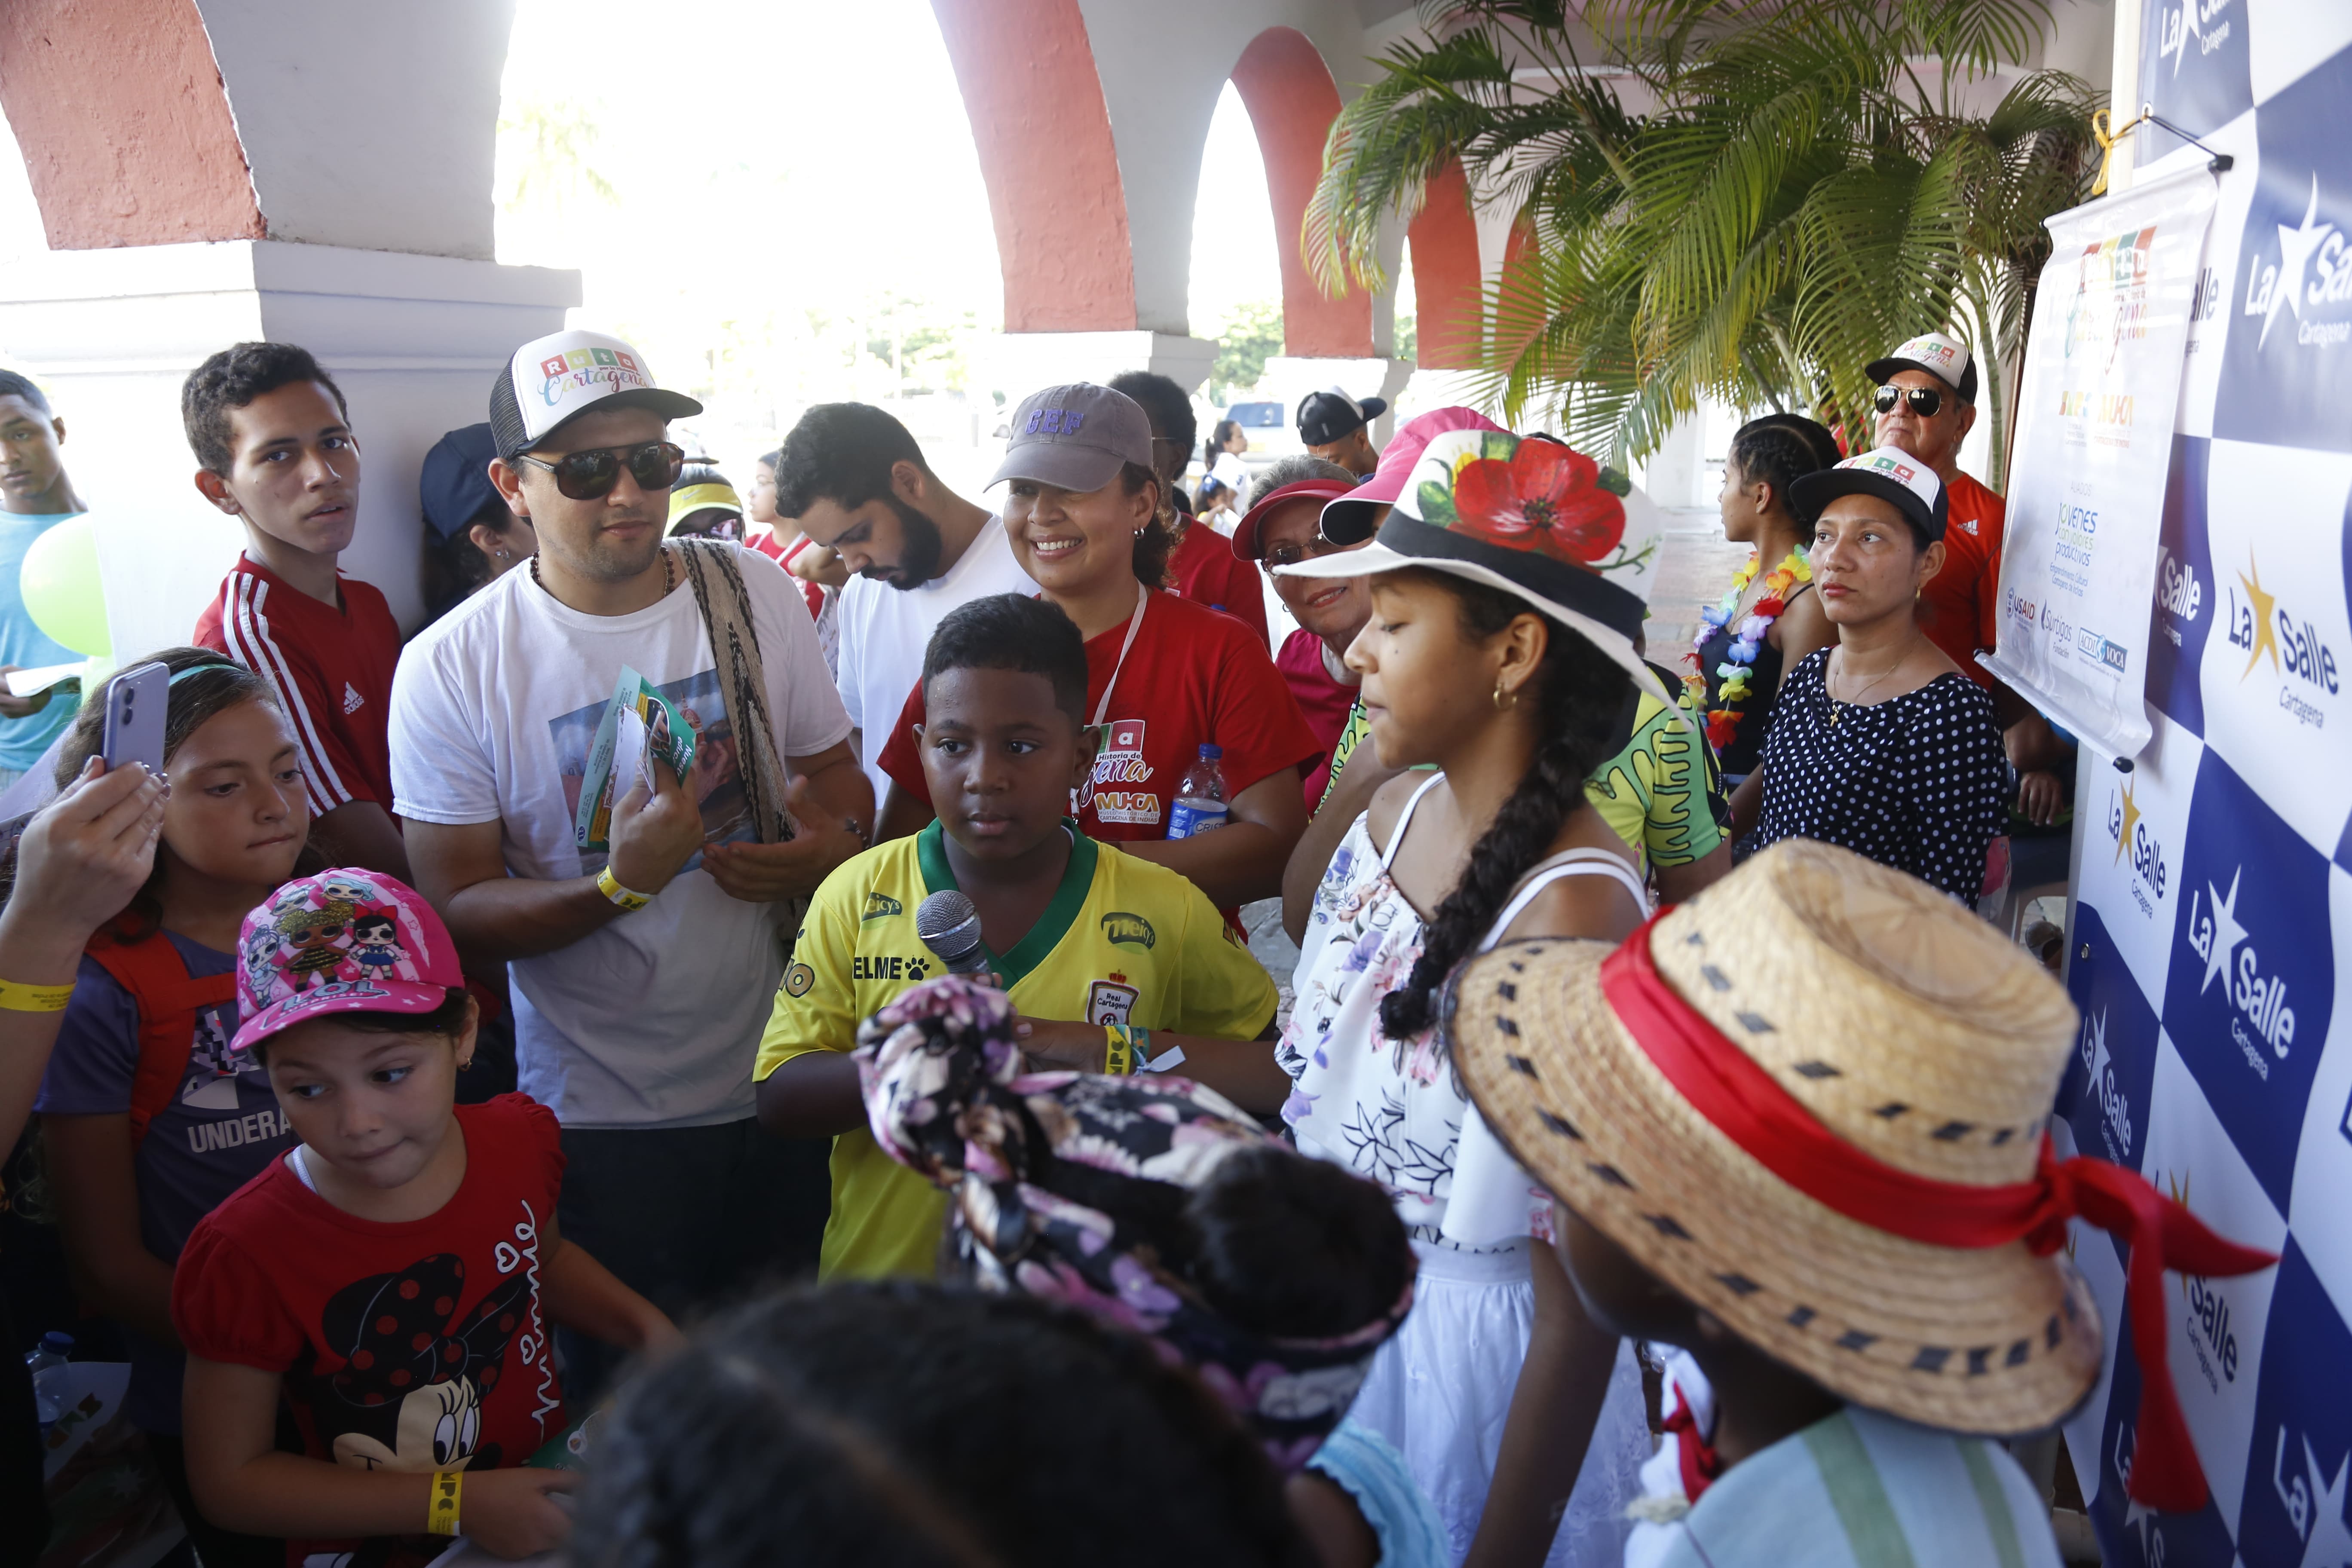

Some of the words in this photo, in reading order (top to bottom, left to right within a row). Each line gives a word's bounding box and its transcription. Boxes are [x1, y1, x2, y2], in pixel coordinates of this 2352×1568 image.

[2160, 6, 2180, 58] La
[2244, 254, 2276, 316] La
[546, 352, 631, 375] Ruta
[537, 368, 649, 406] Cartagena
[1025, 409, 1084, 435] GEF
[2070, 481, 2092, 497] ALIADOS
[1957, 523, 1978, 536] adidas
[2055, 542, 2091, 567] productivos
[2161, 557, 2201, 622] Salle
[2014, 595, 2035, 620] USAID
[2046, 609, 2073, 643] Surtigas
[2229, 586, 2252, 652] La
[2279, 608, 2339, 695] Salle
[2079, 634, 2096, 653] ACDI
[2106, 646, 2124, 668] VOCA
[344, 695, 364, 715] adidas
[2279, 686, 2324, 729] Cartagena
[673, 736, 683, 763] educ
[677, 744, 692, 776] Nuest
[1099, 753, 1128, 761] Historia
[2108, 788, 2121, 843] La
[2135, 823, 2166, 900] Salle
[865, 894, 900, 914] eicy's
[2132, 878, 2153, 920] Cartagena
[2188, 889, 2212, 965] La
[2235, 946, 2295, 1060] Salle
[1097, 998, 1128, 1010] Cartagena
[1106, 993, 1121, 1002] Real
[2231, 1017, 2269, 1082] Cartagena
[2082, 1016, 2094, 1075] La
[2105, 1068, 2132, 1157] Salle
[2101, 1119, 2121, 1168] Cartagena
[2187, 1316, 2218, 1395] Cartagena
[2273, 1423, 2309, 1544] La
